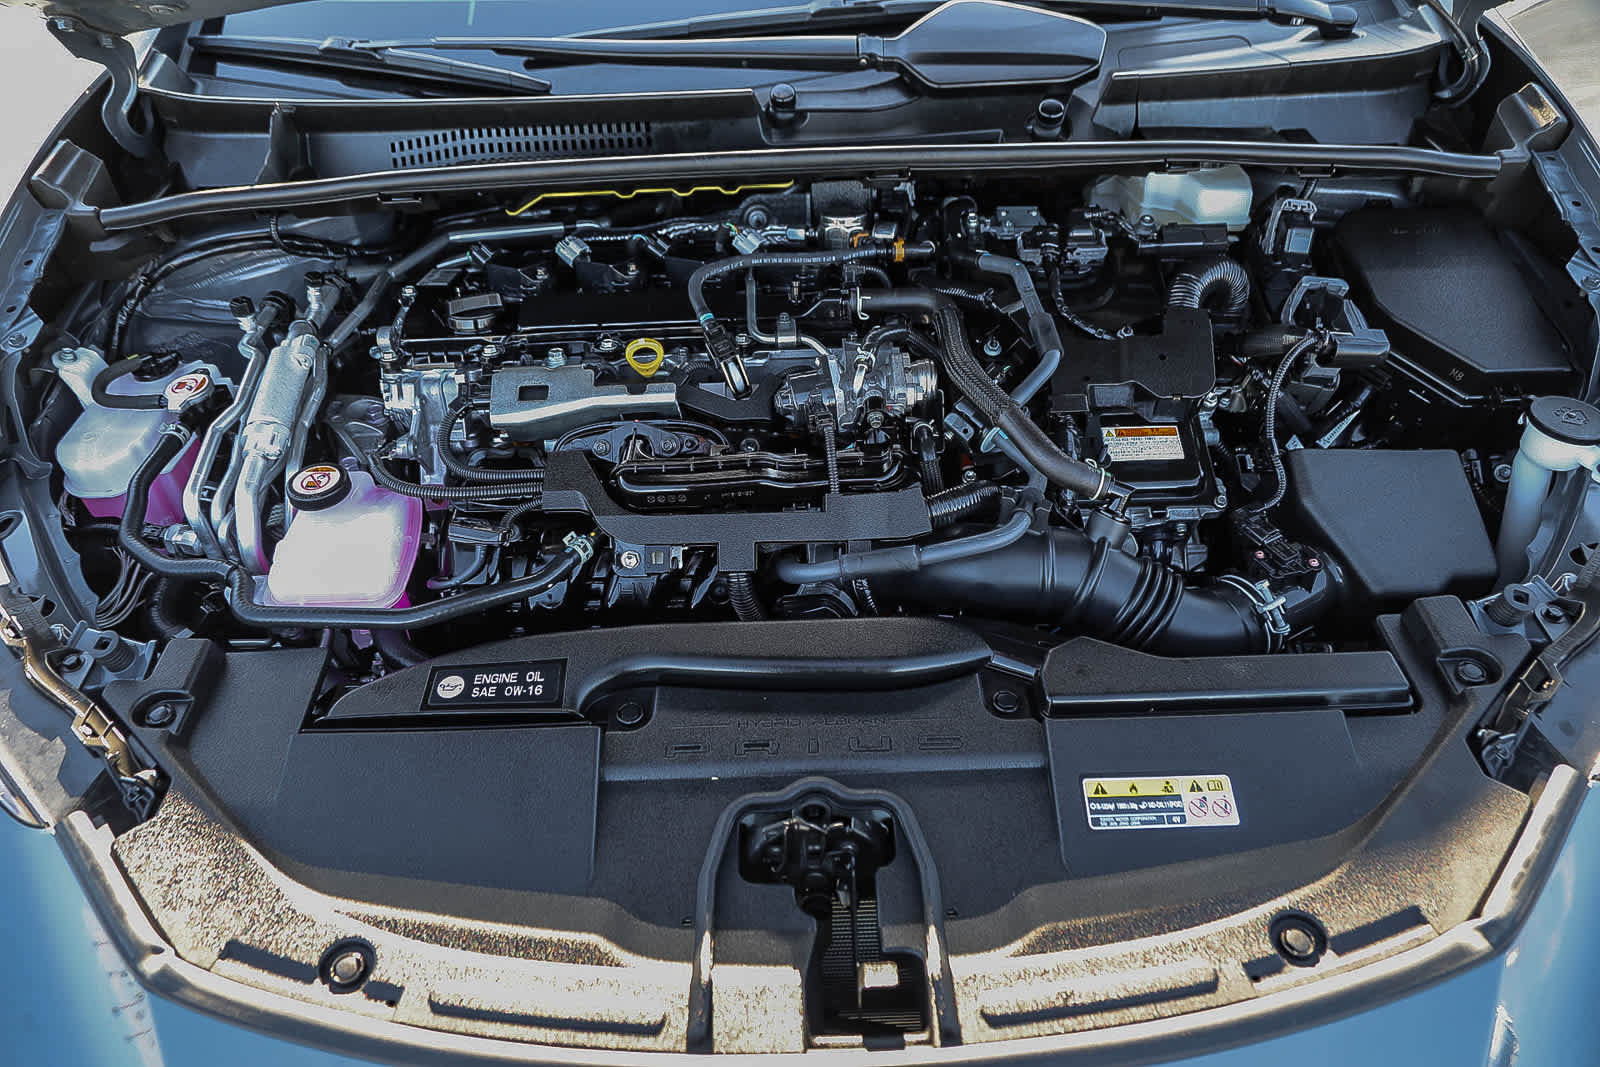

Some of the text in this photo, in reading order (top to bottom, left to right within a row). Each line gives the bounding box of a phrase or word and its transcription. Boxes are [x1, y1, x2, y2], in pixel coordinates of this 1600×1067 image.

[473, 671, 545, 685] ENGINE OIL
[471, 684, 543, 698] SAE 0W-16
